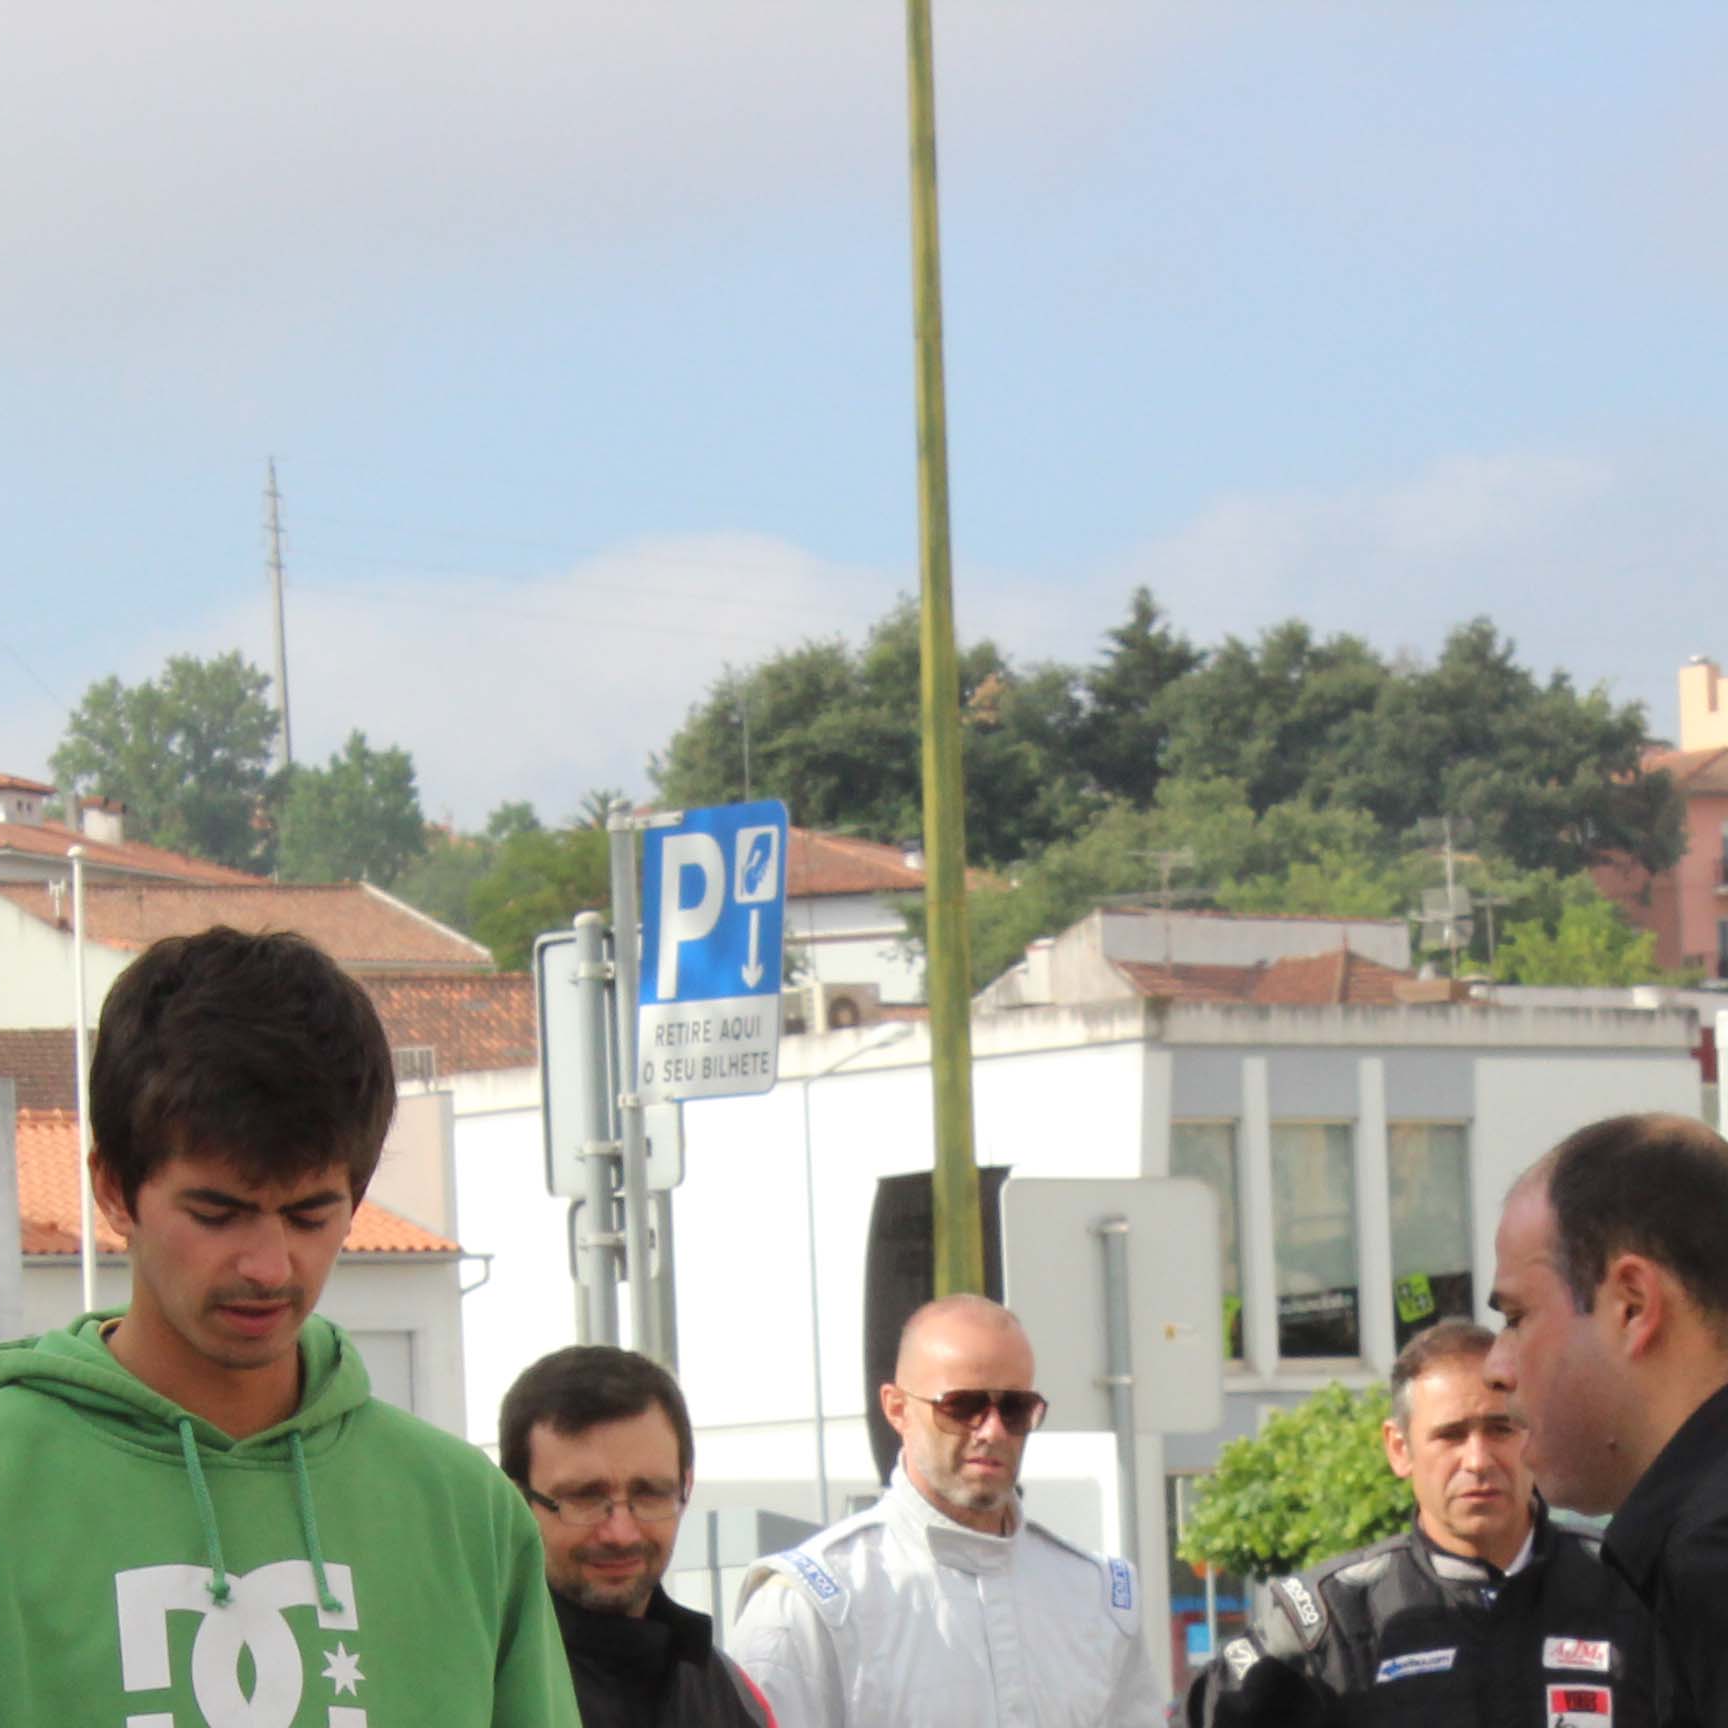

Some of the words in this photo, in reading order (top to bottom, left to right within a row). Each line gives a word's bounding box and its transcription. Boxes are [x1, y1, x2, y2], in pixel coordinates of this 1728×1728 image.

[657, 832, 726, 999] P
[655, 1018, 712, 1047] RETIRE
[720, 1015, 762, 1041] AQUI
[643, 1063, 655, 1085] O
[663, 1059, 696, 1081] SEU
[702, 1050, 770, 1079] BILHETE
